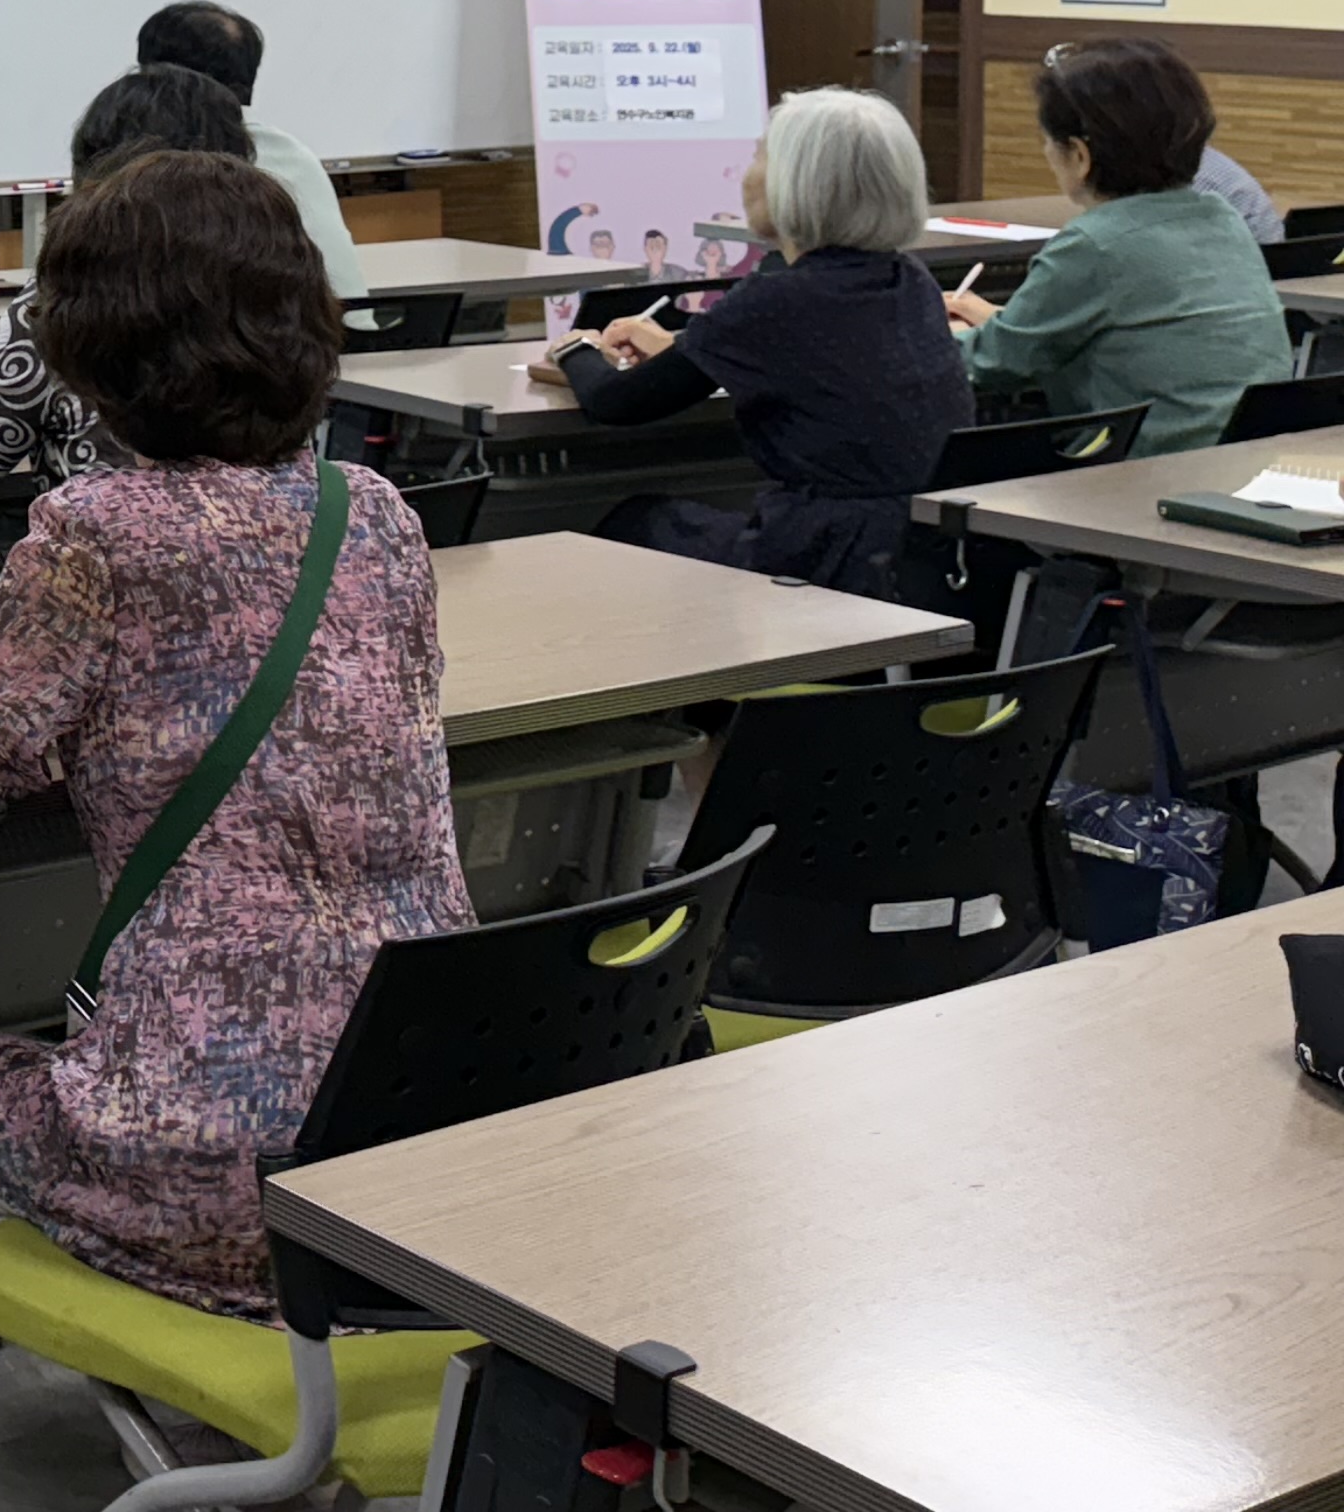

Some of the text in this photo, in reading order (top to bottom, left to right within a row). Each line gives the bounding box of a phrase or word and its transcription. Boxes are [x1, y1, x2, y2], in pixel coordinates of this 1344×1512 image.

[545, 41, 594, 55] 교육일자
[612, 42, 642, 54] 2025.
[546, 75, 596, 88] 교육시간
[616, 75, 640, 87] 오후
[548, 109, 599, 122] 교육장소
